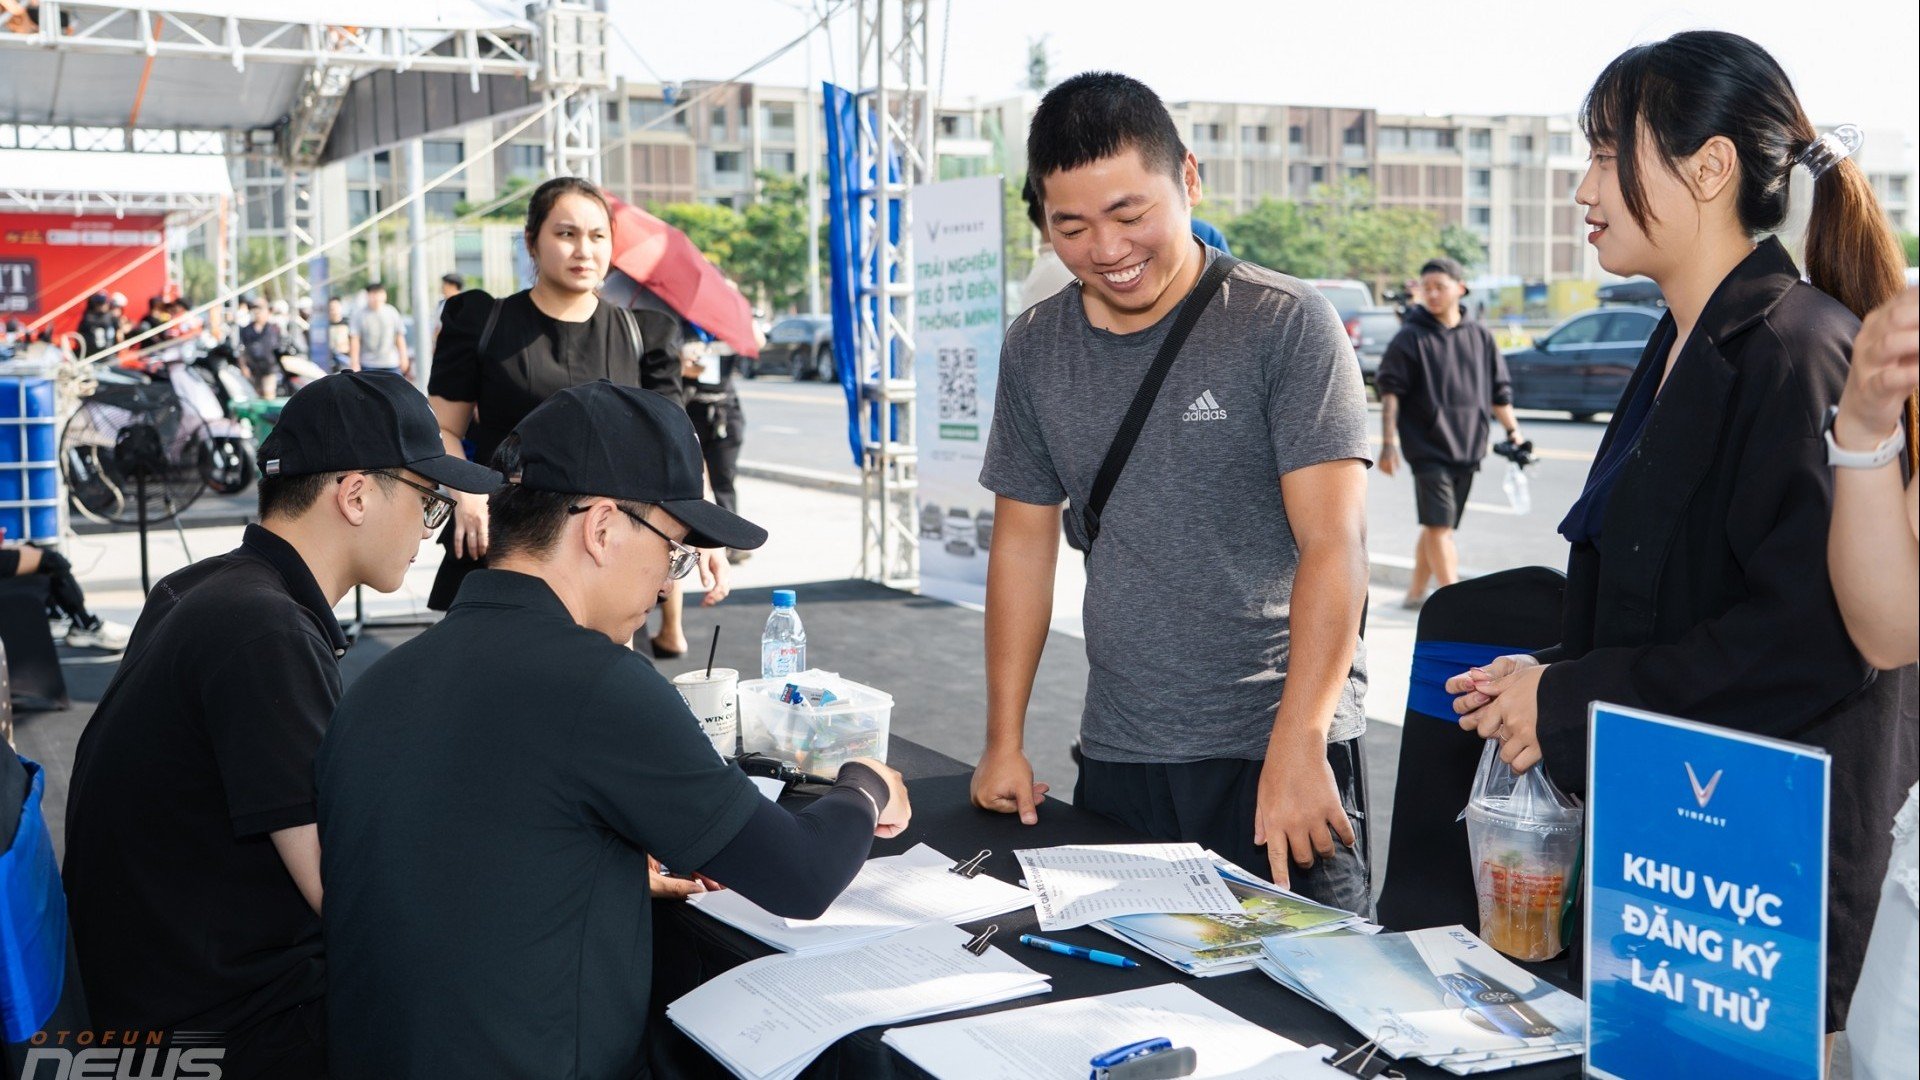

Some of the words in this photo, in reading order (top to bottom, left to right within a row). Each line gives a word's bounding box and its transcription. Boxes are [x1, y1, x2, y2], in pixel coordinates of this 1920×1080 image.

[917, 288, 930, 306] XE
[918, 308, 961, 331] THÔNG
[964, 308, 998, 327] MINH
[1182, 409, 1227, 421] adidas
[705, 715, 724, 724] WIN
[1677, 807, 1726, 827] VINFAST
[1623, 852, 1696, 899] KHU
[1702, 875, 1783, 927] VỰC
[1621, 904, 1723, 962] ĐĂNG
[1732, 938, 1782, 980] KÝ
[1631, 957, 1684, 1003] LÁI
[1692, 978, 1770, 1032] THỬ
